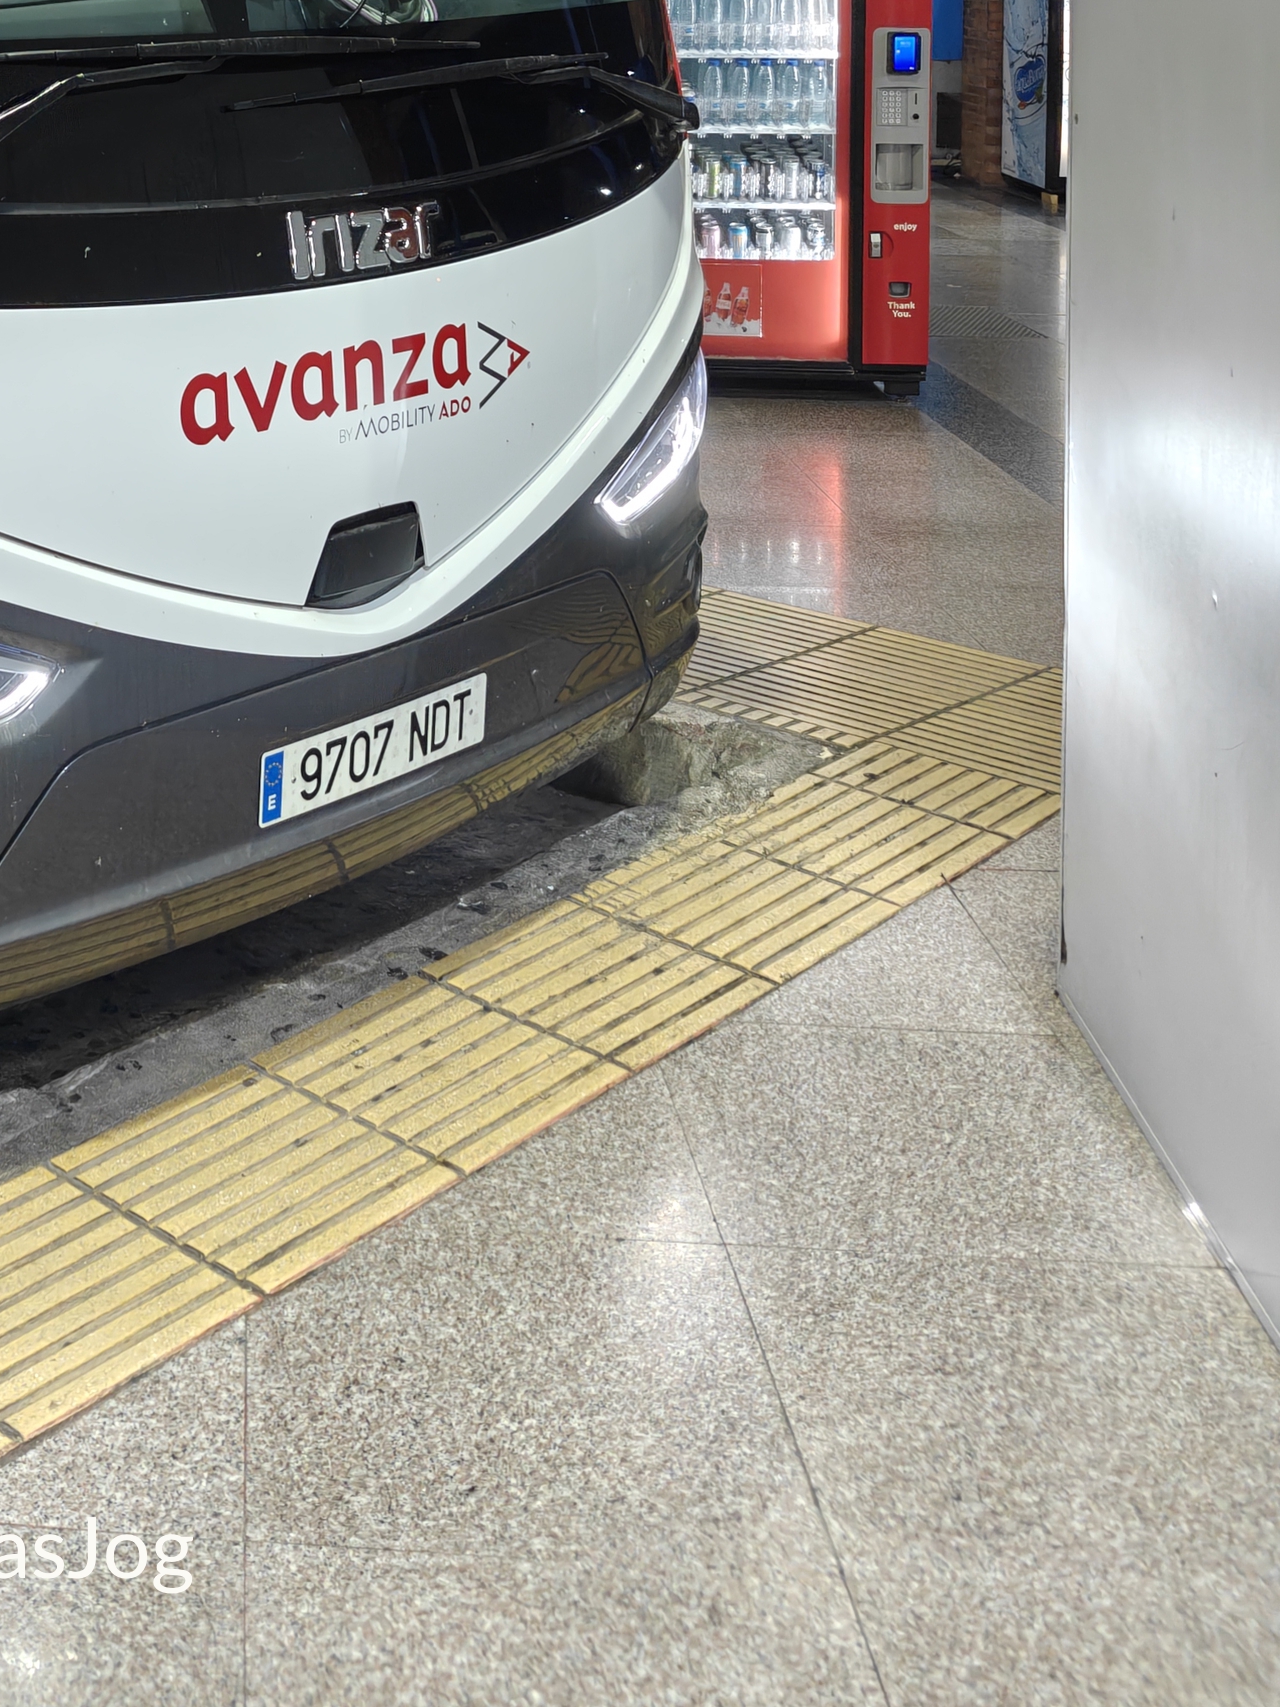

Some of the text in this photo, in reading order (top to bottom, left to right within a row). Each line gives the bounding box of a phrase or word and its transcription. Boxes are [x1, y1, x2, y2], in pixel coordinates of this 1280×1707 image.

[286, 199, 440, 280] Irizar
[893, 222, 918, 232] enjoy
[887, 301, 916, 310] Thank
[892, 310, 912, 318] You.
[180, 322, 472, 445] avanza
[338, 395, 471, 444] BY MOBILITY ADO
[300, 688, 472, 801] 9707 NDT
[267, 793, 277, 811] E
